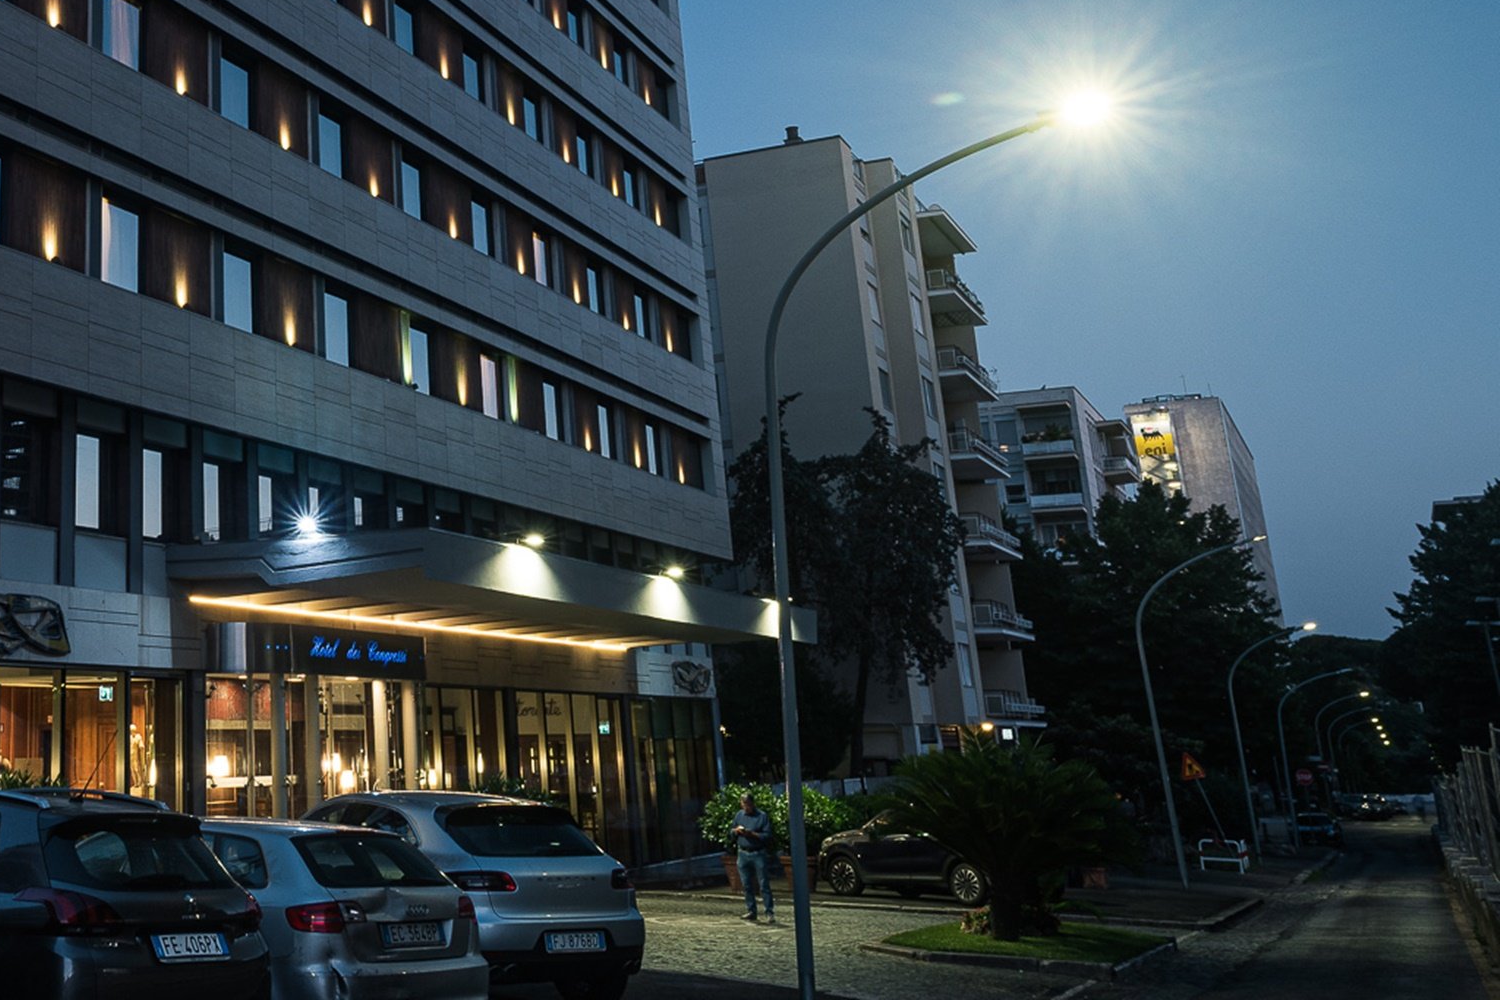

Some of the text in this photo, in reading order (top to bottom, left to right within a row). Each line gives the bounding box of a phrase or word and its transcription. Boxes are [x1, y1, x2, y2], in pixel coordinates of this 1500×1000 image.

[1145, 442, 1167, 457] eni
[310, 635, 407, 667] Hotel dei Congressi
[161, 934, 222, 955] FE 406PX
